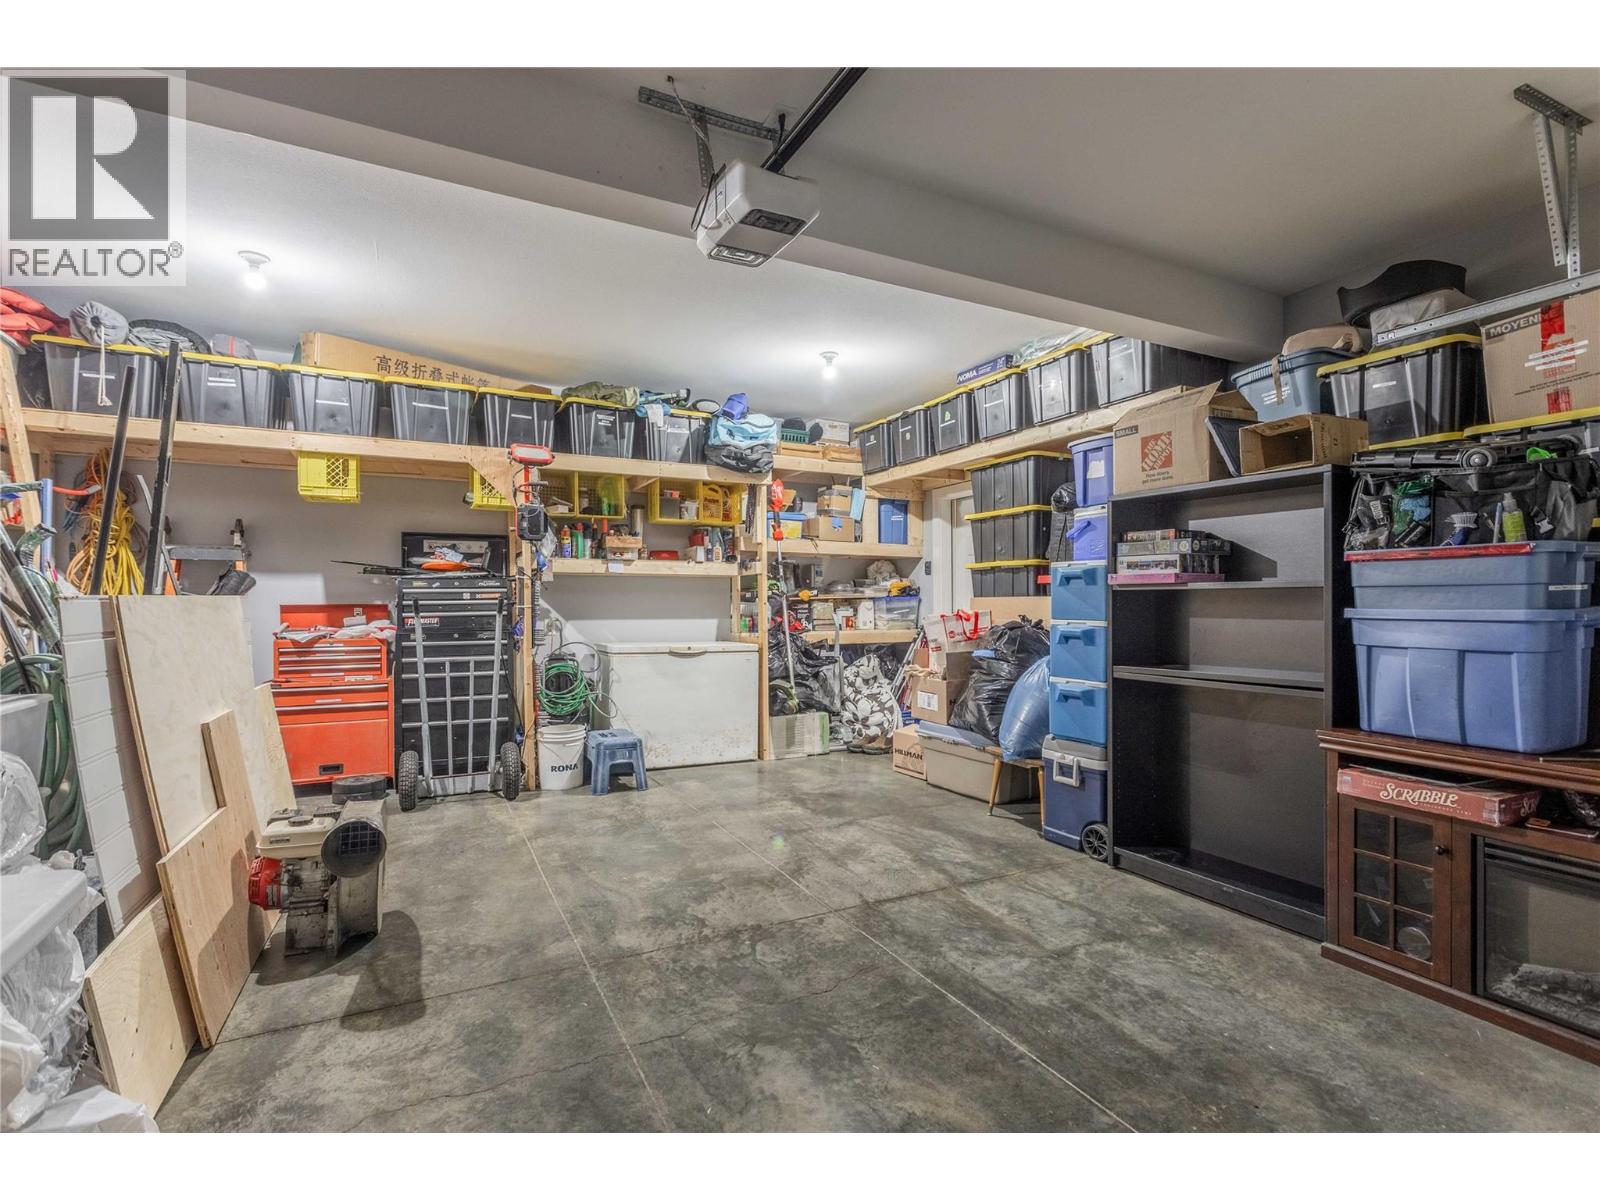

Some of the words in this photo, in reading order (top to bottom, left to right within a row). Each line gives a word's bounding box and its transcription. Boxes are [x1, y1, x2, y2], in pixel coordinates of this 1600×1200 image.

[957, 369, 978, 383] NOMA
[1115, 426, 1137, 438] SMALL
[1142, 433, 1172, 470] HOME
[894, 747, 924, 761] HILLMAN
[550, 763, 579, 773] RONA
[1379, 782, 1460, 807] SCRABBLE
